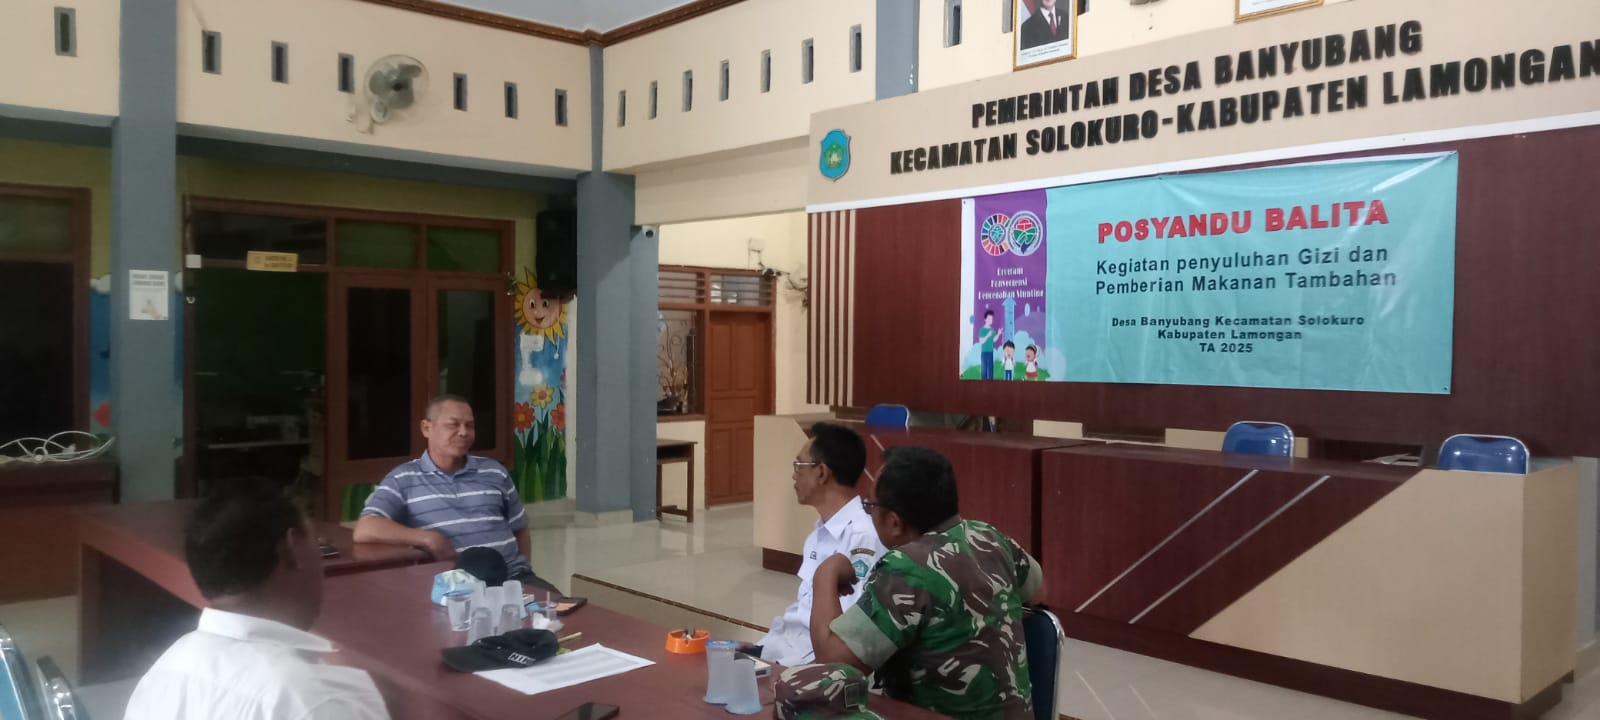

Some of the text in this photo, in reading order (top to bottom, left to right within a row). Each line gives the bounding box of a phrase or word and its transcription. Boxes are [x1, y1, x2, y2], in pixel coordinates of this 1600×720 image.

[972, 20, 1422, 129] PEMERINTAH DESA BANYUBANG
[890, 136, 1018, 175] KECAMATAN
[1383, 38, 1600, 105] LAMONGAN
[1098, 199, 1389, 244] POSYANDU BALITA
[1096, 246, 1388, 277] Kegiatan penyuluhan Gizi dan
[1096, 270, 1396, 295] Pemberian Makanan Tambahan
[1112, 315, 1365, 328] Desa Banyubang Kecamatan Solokuro
[1157, 329, 1303, 342] Kabupaten Lamongan
[1200, 342, 1253, 353] TA 2025
